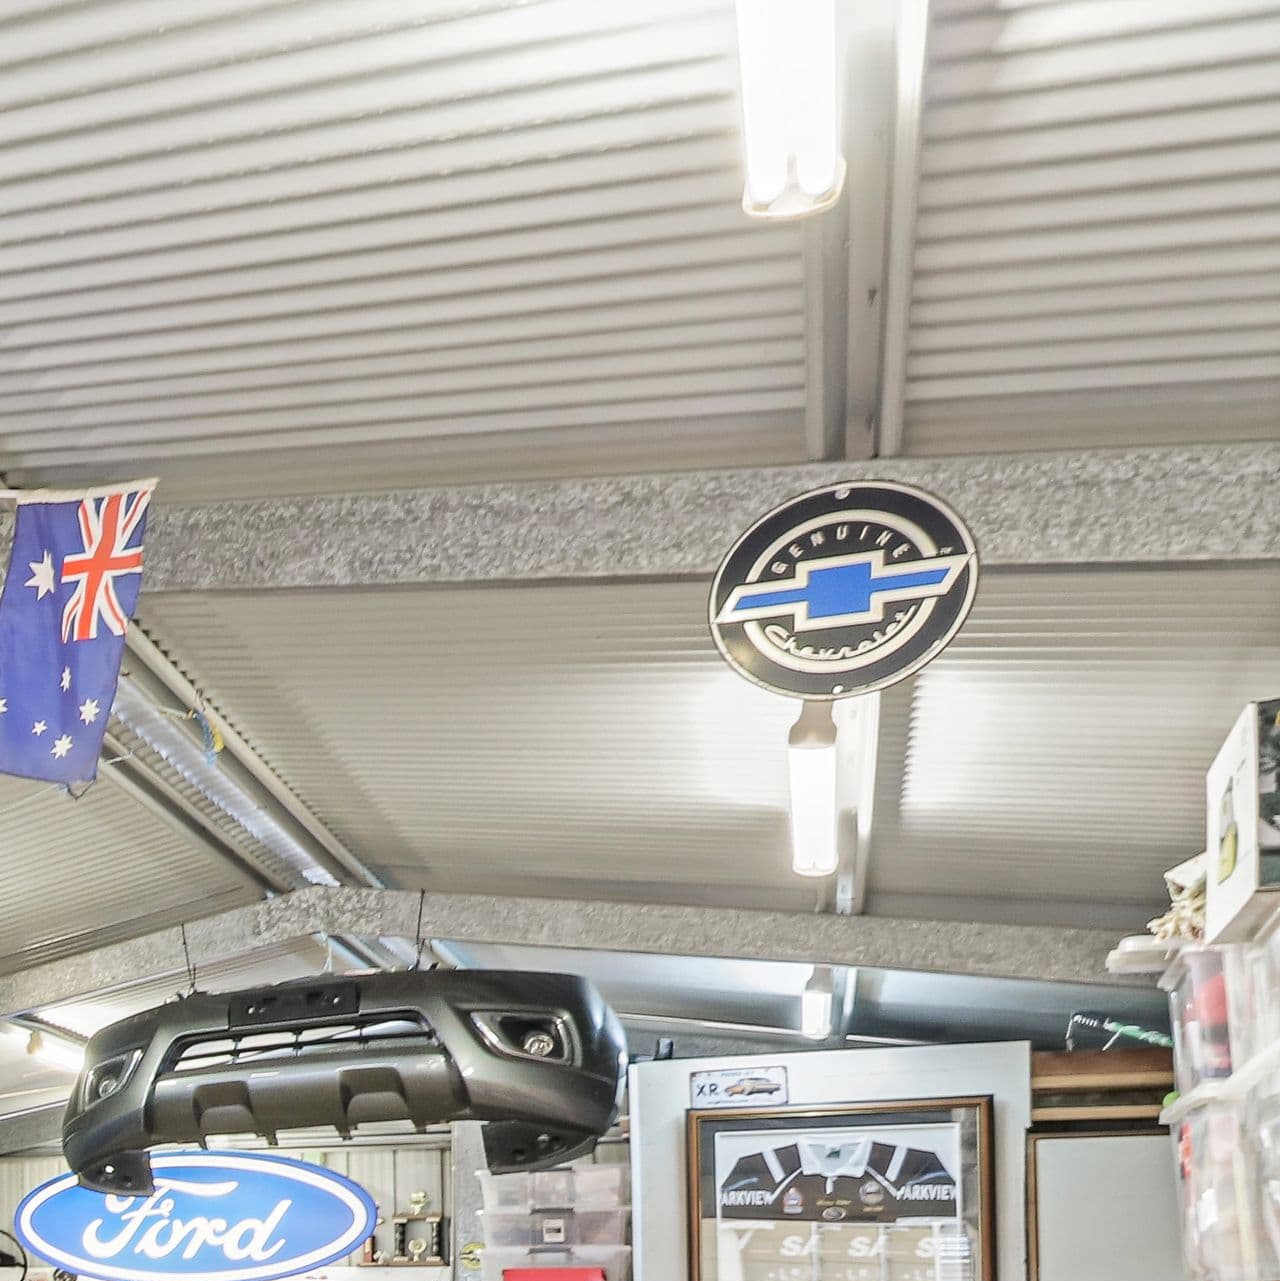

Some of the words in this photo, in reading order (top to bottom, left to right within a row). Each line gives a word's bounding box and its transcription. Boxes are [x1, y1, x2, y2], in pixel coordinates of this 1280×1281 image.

[770, 525, 914, 575] GENUINE
[764, 604, 916, 660] Chevrolet
[696, 1083, 718, 1097] XR
[82, 1177, 292, 1262] Ford
